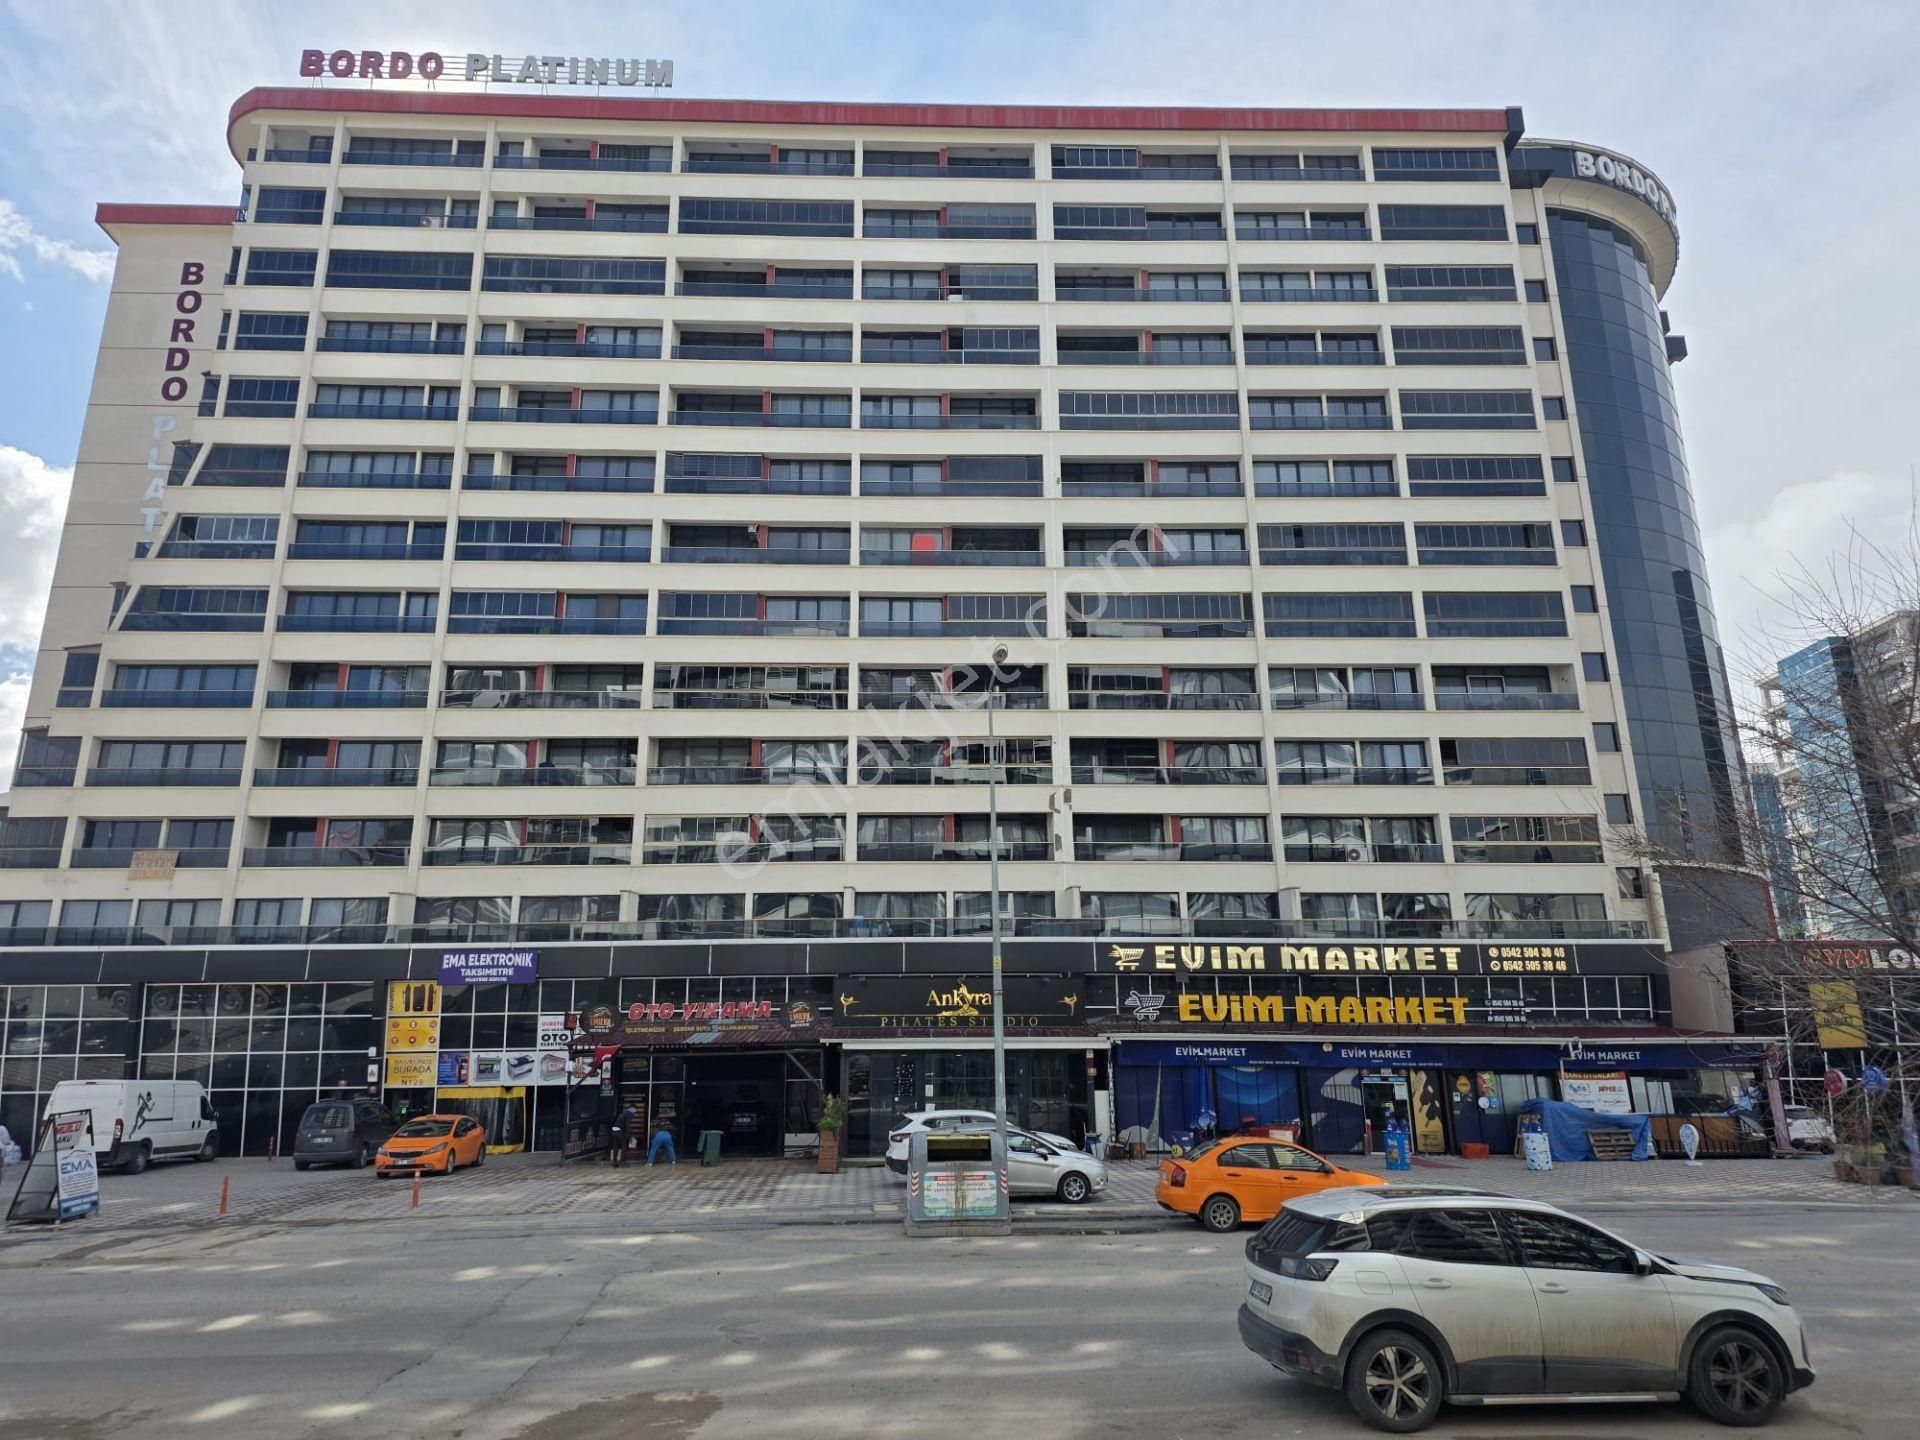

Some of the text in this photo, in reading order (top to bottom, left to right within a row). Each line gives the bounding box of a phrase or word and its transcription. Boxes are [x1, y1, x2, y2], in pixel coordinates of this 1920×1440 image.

[299, 49, 673, 88] BORDO PLATINUM
[1575, 151, 1660, 204] BORDO
[161, 262, 205, 402] BORDO
[442, 954, 466, 969] EMA
[1280, 945, 1462, 972] MARKET
[628, 1002, 675, 1020] OTO
[681, 1000, 772, 1020] YIKAMA
[1295, 996, 1468, 1024] MARKET
[968, 1016, 1039, 1027] STDIO
[541, 1033, 569, 1042] OTO
[1203, 1047, 1247, 1057] MARKET
[1369, 1049, 1413, 1059] MARKET
[1597, 1051, 1641, 1061] MARKET
[393, 1065, 432, 1074] BURADA
[60, 1159, 94, 1175] EMA
